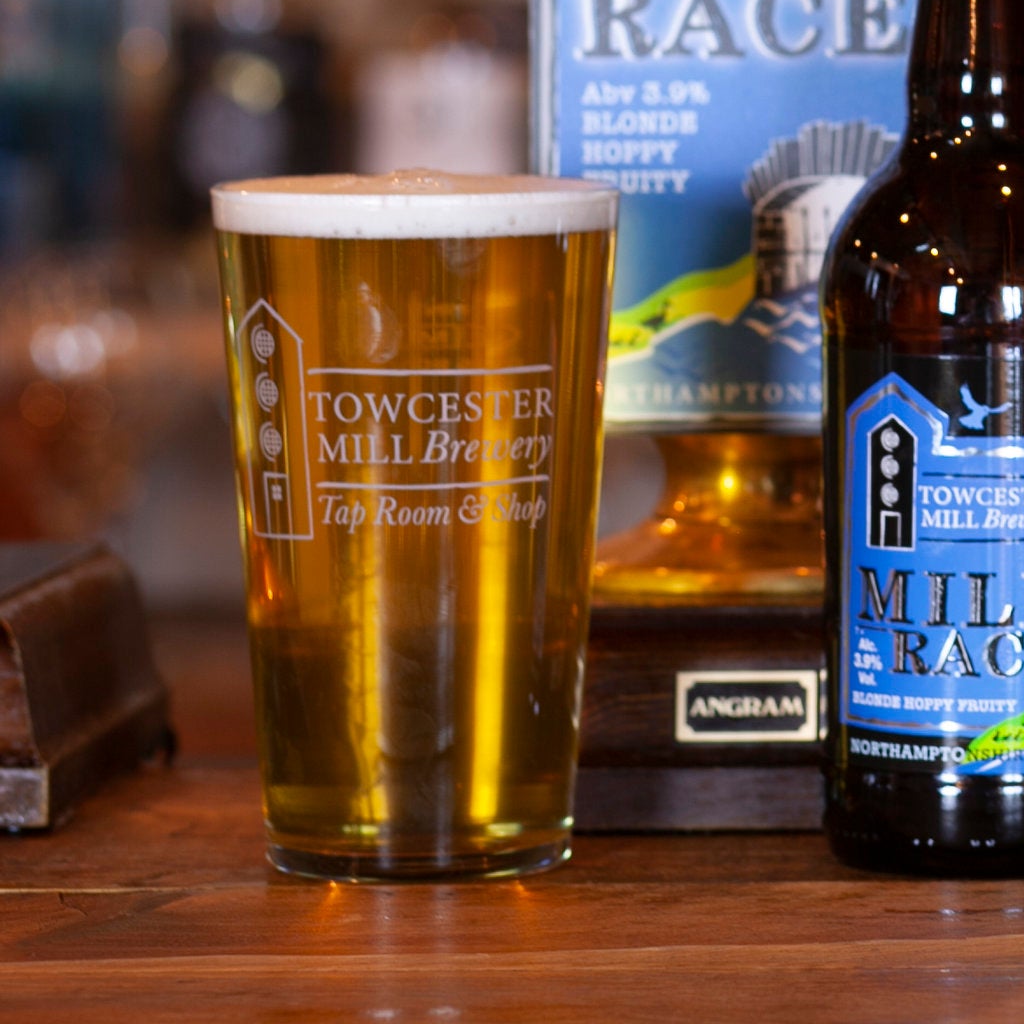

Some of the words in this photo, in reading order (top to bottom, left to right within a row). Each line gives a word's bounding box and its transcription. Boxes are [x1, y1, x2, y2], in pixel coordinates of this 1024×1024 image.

[581, 80, 635, 106] Abv
[641, 80, 711, 106] 3.9%
[581, 110, 699, 135] BLONDE
[581, 139, 679, 165] HOPPY
[308, 387, 553, 424] TOWCESTER
[317, 432, 413, 465] MILL
[419, 429, 551, 470] Brewery
[317, 494, 366, 534] Tap
[372, 495, 452, 527] Room
[457, 494, 487, 525] &
[491, 492, 547, 529] Shop
[920, 510, 979, 529] MILL
[689, 695, 804, 718] ANGRAM
[852, 690, 901, 710] BLONDE
[903, 696, 954, 713] HOPPY
[957, 697, 1018, 713] FRUITY
